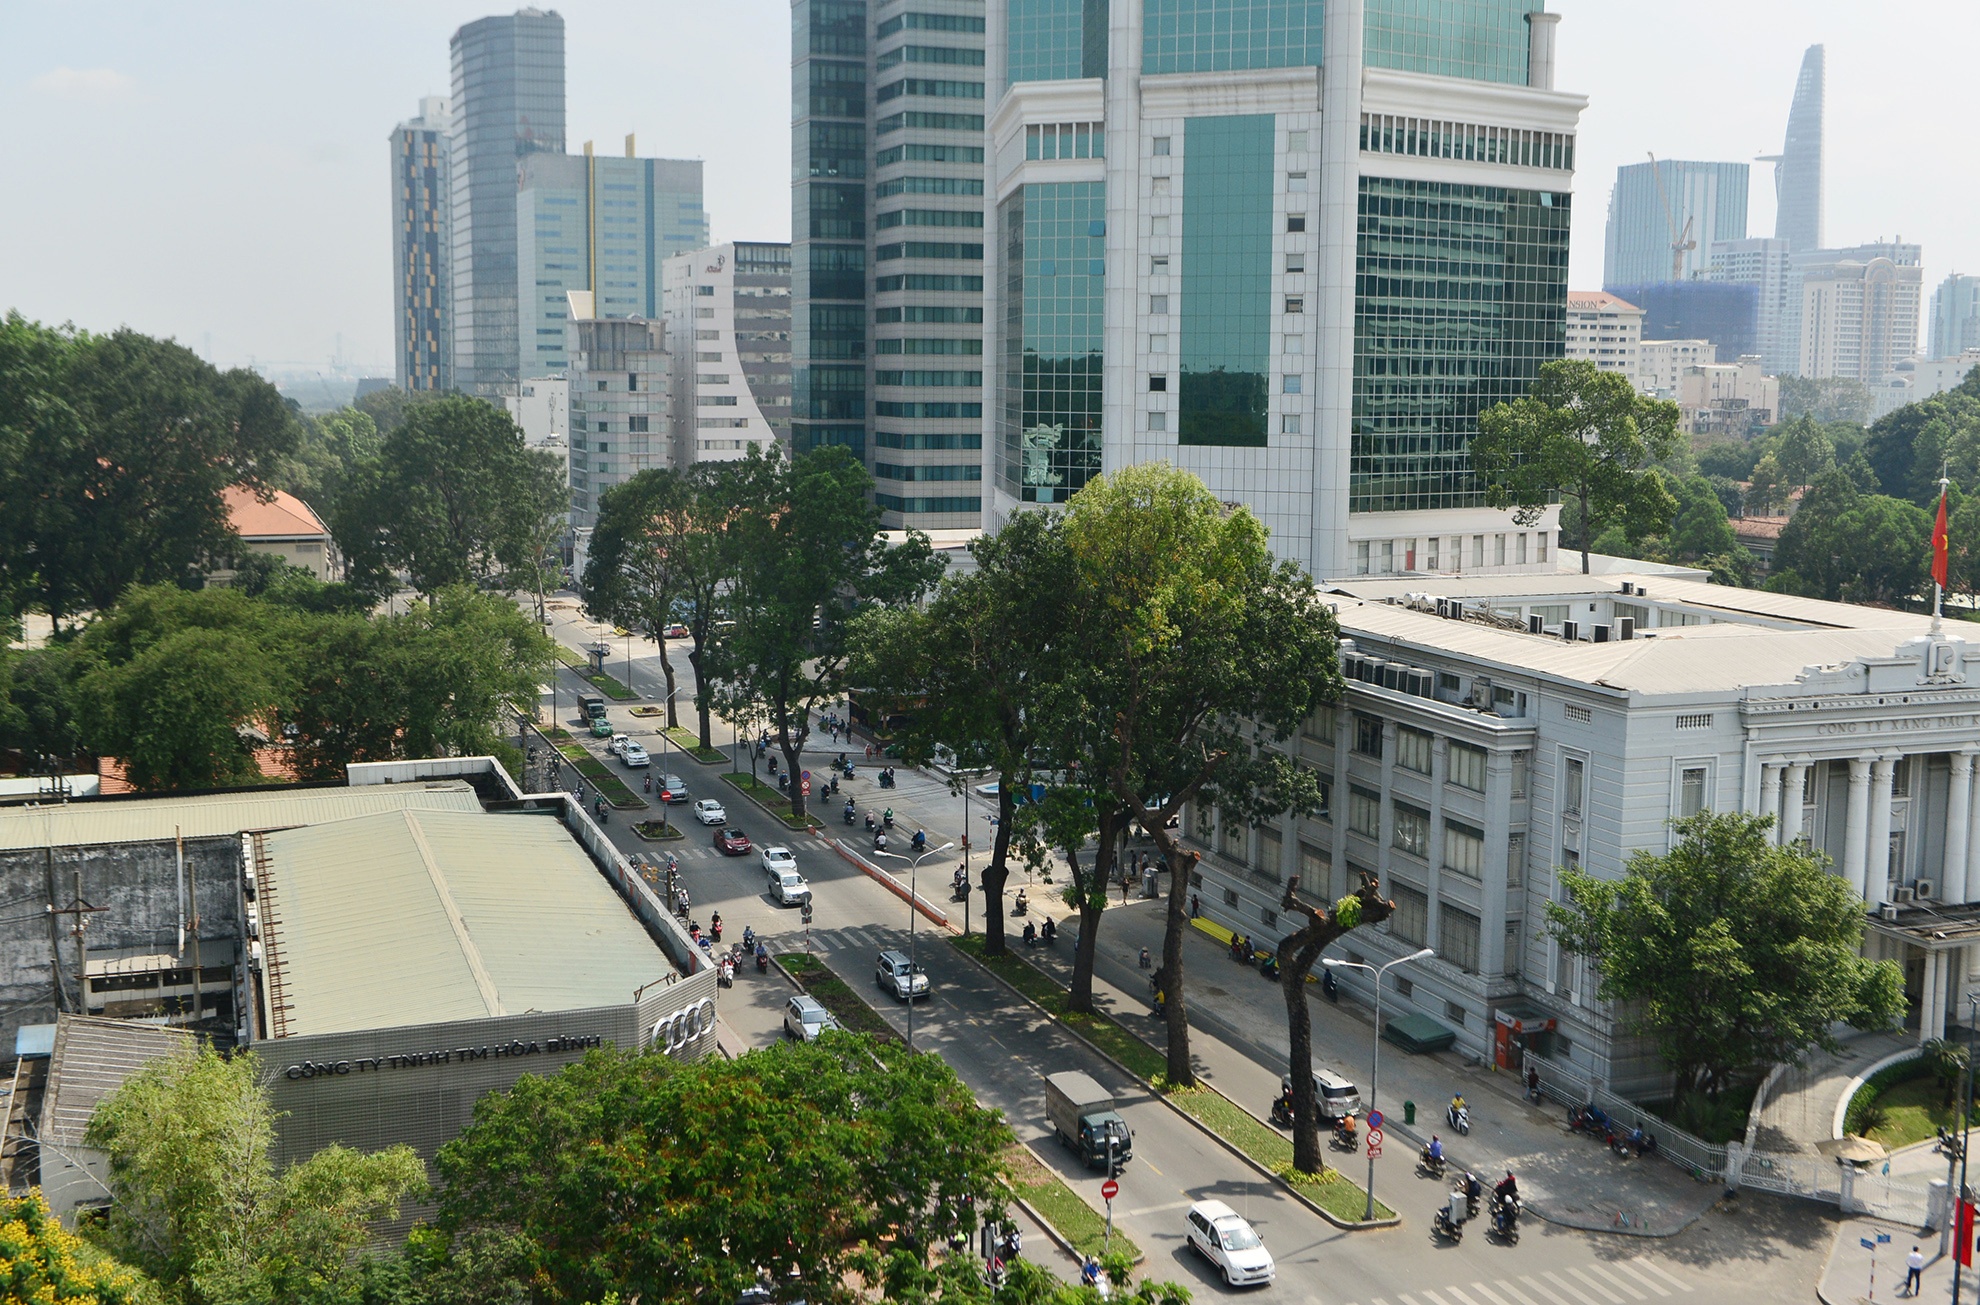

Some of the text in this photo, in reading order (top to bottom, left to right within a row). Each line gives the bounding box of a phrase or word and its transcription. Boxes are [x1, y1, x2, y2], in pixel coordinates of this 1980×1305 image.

[1867, 721, 1883, 731] TY
[286, 1034, 601, 1080] CÔNG TY TNHH TM HÒA BÌNH
